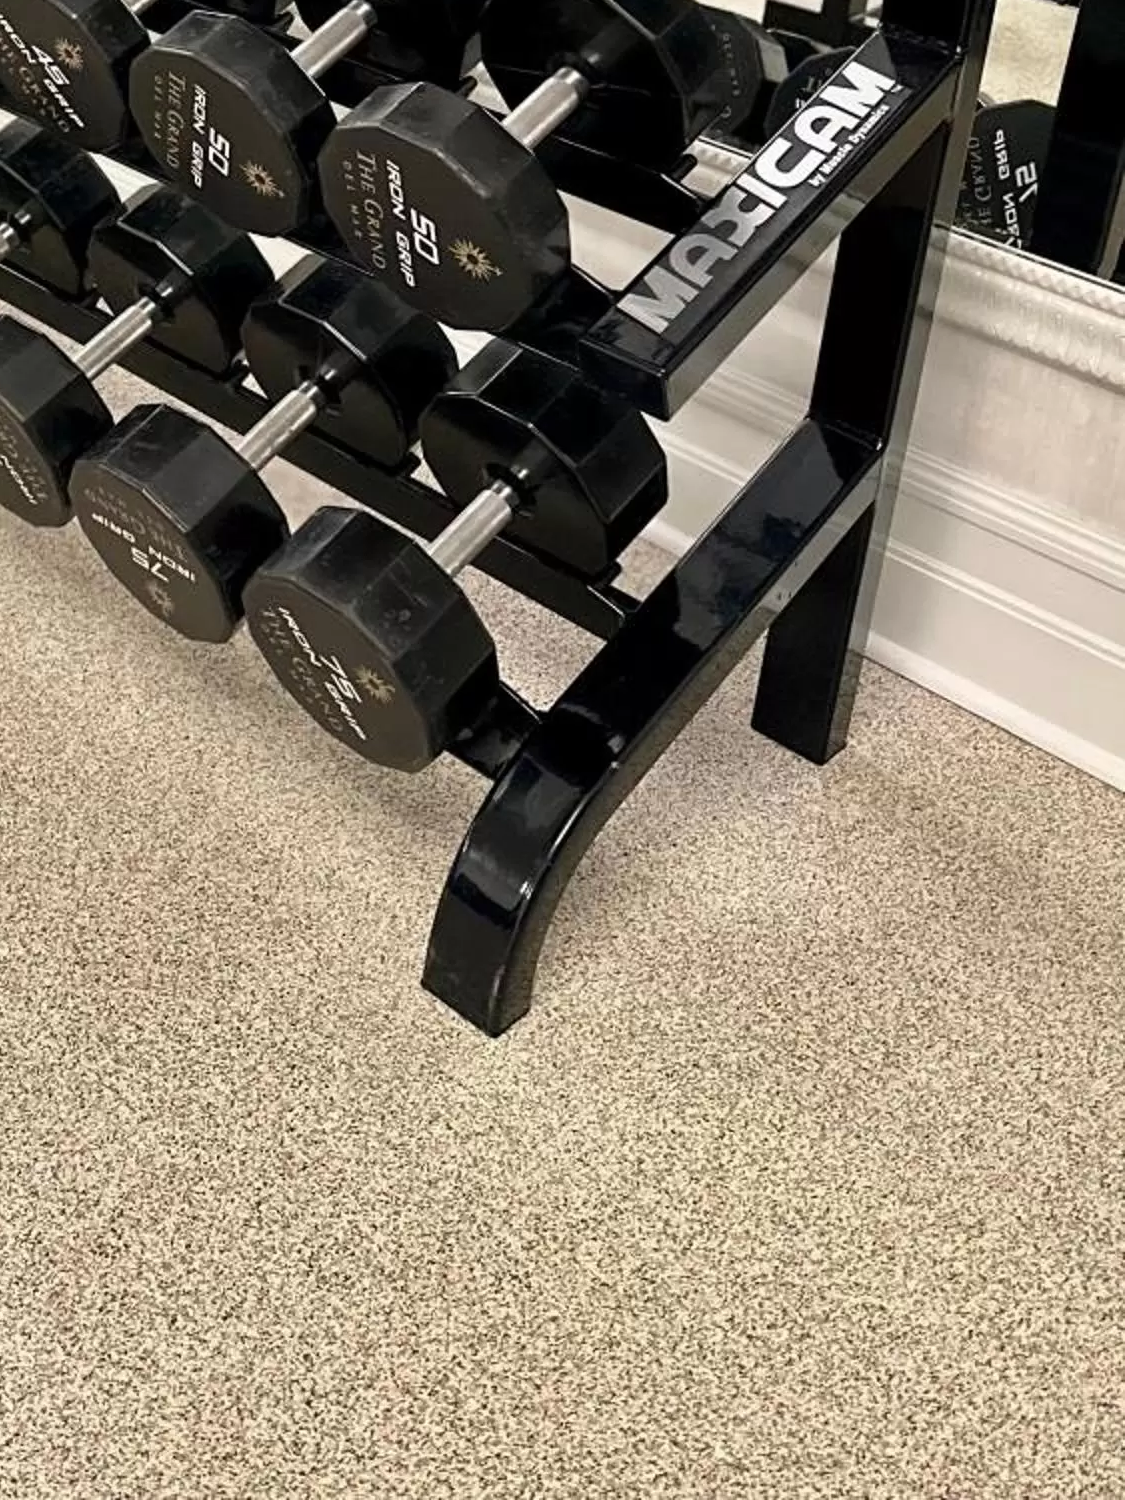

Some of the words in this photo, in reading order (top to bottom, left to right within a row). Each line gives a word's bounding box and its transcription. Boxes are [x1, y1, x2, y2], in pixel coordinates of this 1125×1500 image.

[30, 43, 71, 86] 45
[166, 70, 187, 107] THE
[18, 64, 71, 133] GRAND
[42, 77, 86, 129] GRIP
[190, 83, 208, 136] IRON
[165, 108, 187, 170] GRAND
[190, 140, 204, 190] GRIP
[207, 127, 231, 178] 50
[355, 147, 377, 198] THE
[385, 158, 409, 223] IRON
[616, 61, 896, 334] MAXICAM
[807, 173, 826, 187] by
[363, 199, 389, 271] GRAND
[394, 229, 418, 288] GRIP
[410, 206, 441, 267] 50
[0, 452, 39, 506] IRON
[92, 512, 136, 544] GRIP
[131, 546, 170, 584] 75
[148, 544, 196, 584] IRON
[276, 605, 323, 668] IRON
[324, 680, 367, 740] GRIP
[319, 653, 363, 704] 75
